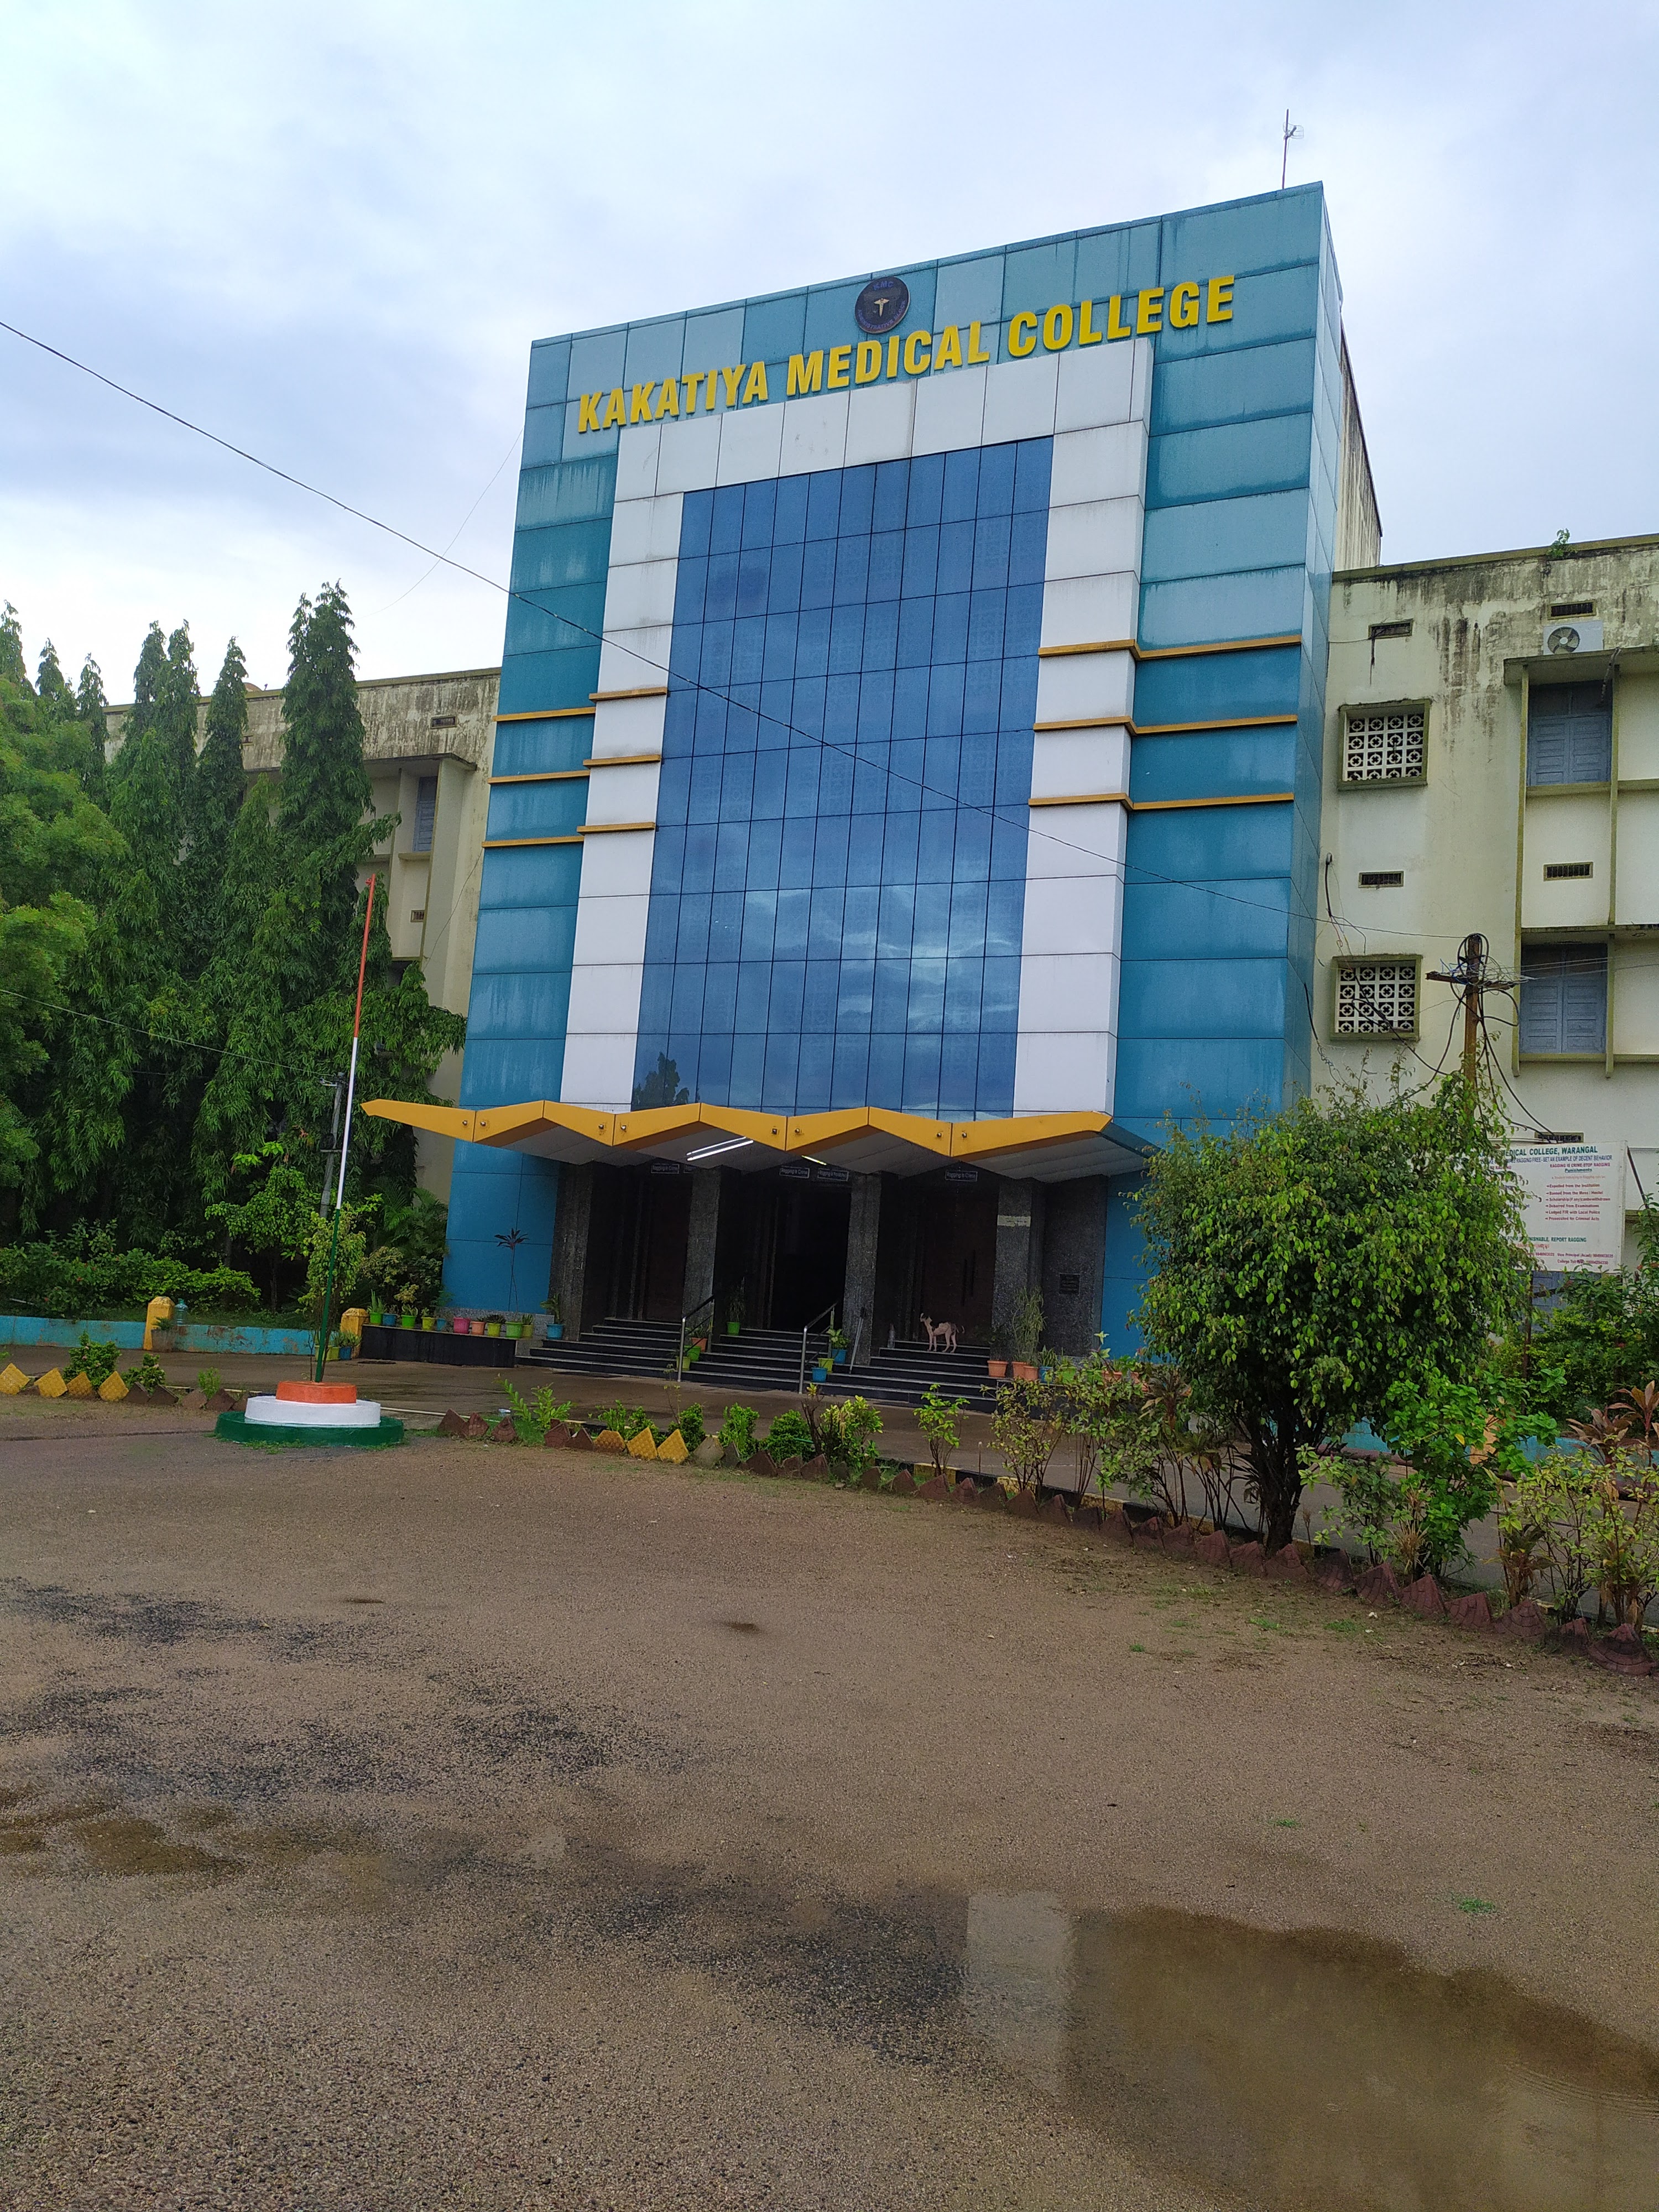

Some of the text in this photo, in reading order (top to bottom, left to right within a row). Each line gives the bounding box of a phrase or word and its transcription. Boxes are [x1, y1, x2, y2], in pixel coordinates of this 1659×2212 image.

[873, 281, 894, 290] KMC
[858, 300, 906, 329] ADMINISTRATIVE BLOCK
[578, 275, 1235, 433] KAKATIYA MEDICAL COLLEGE
[1529, 1147, 1559, 1156] COLLEGE,
[1562, 1146, 1598, 1154] WARANGAL
